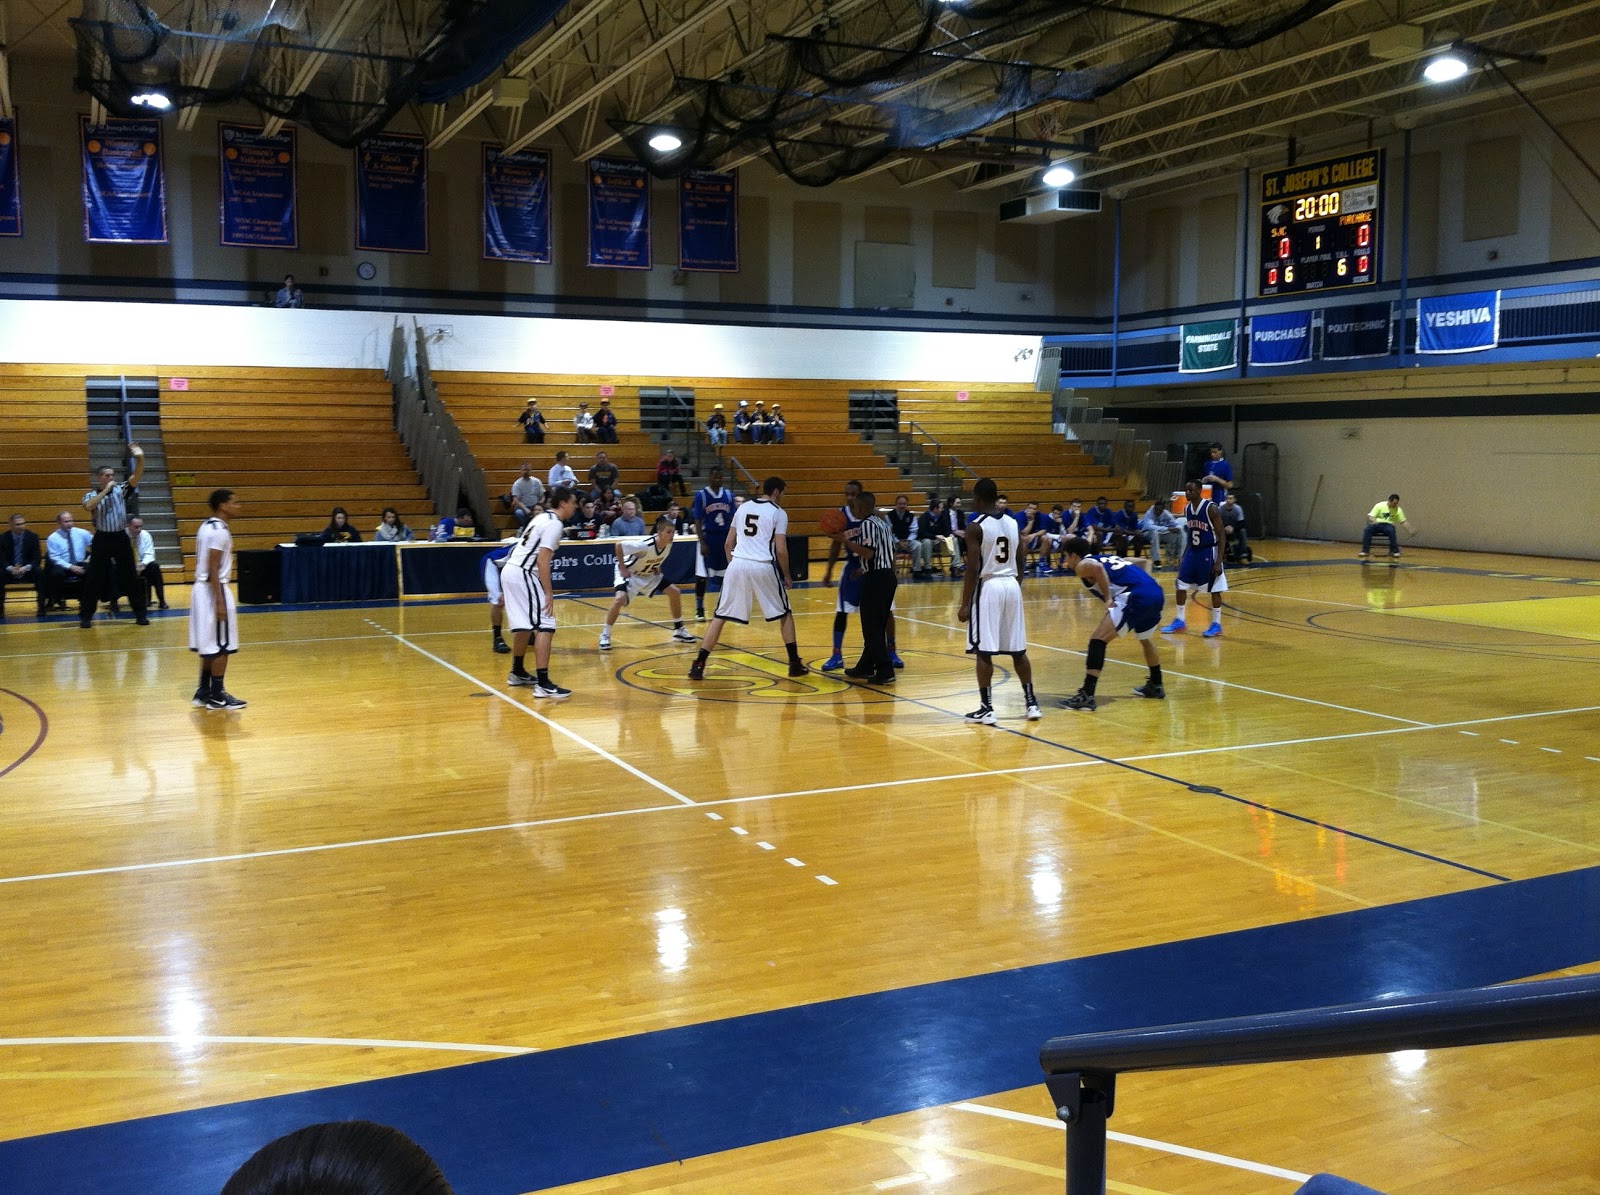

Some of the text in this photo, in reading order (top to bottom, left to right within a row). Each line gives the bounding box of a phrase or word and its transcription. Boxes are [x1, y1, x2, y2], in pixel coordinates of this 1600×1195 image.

[1265, 156, 1375, 197] ST. JOSEPH'S COLLEGE
[1295, 192, 1340, 221] 20:00
[1315, 235, 1321, 250] 1
[1357, 224, 1370, 247] 0
[1278, 237, 1291, 259] 0
[1284, 265, 1294, 283] 6
[1337, 257, 1347, 276] 6
[1327, 319, 1387, 334] POLYTECHNIC
[1425, 307, 1491, 328] YESHIVA
[1185, 331, 1232, 344] FARMINGDALE
[1254, 327, 1308, 342] PURCHASE
[1197, 343, 1219, 353] STATE
[714, 512, 725, 527] 4
[743, 514, 760, 537] 5
[1192, 530, 1201, 546] 5
[995, 536, 1010, 563] 3
[549, 553, 619, 570] eph's Colle
